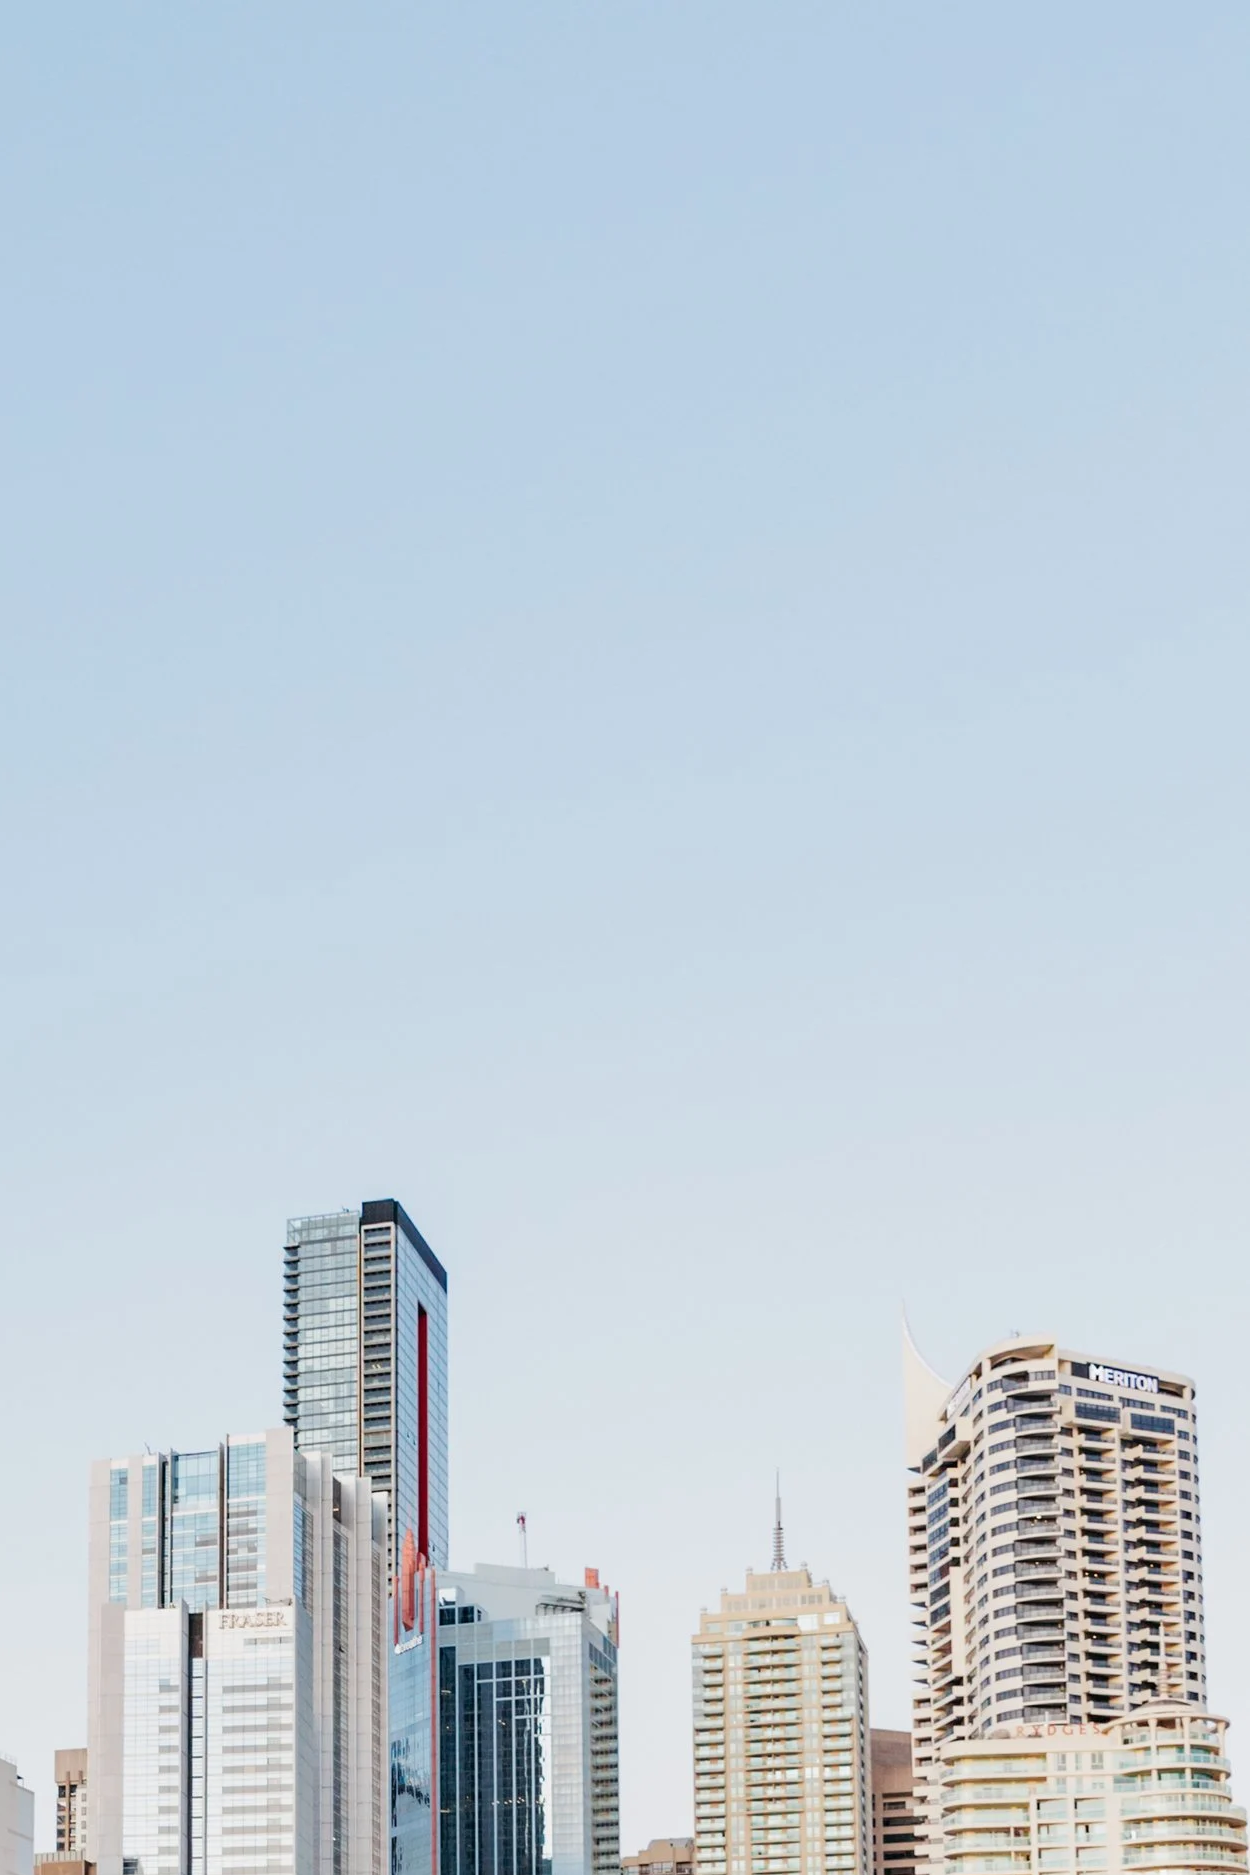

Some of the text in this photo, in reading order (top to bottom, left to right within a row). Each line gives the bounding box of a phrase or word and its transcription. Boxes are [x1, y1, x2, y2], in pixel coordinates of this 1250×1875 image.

[1088, 1363, 1160, 1394] MERITON
[218, 1611, 288, 1630] FRASER
[1015, 1723, 1101, 1738] RYDGES
